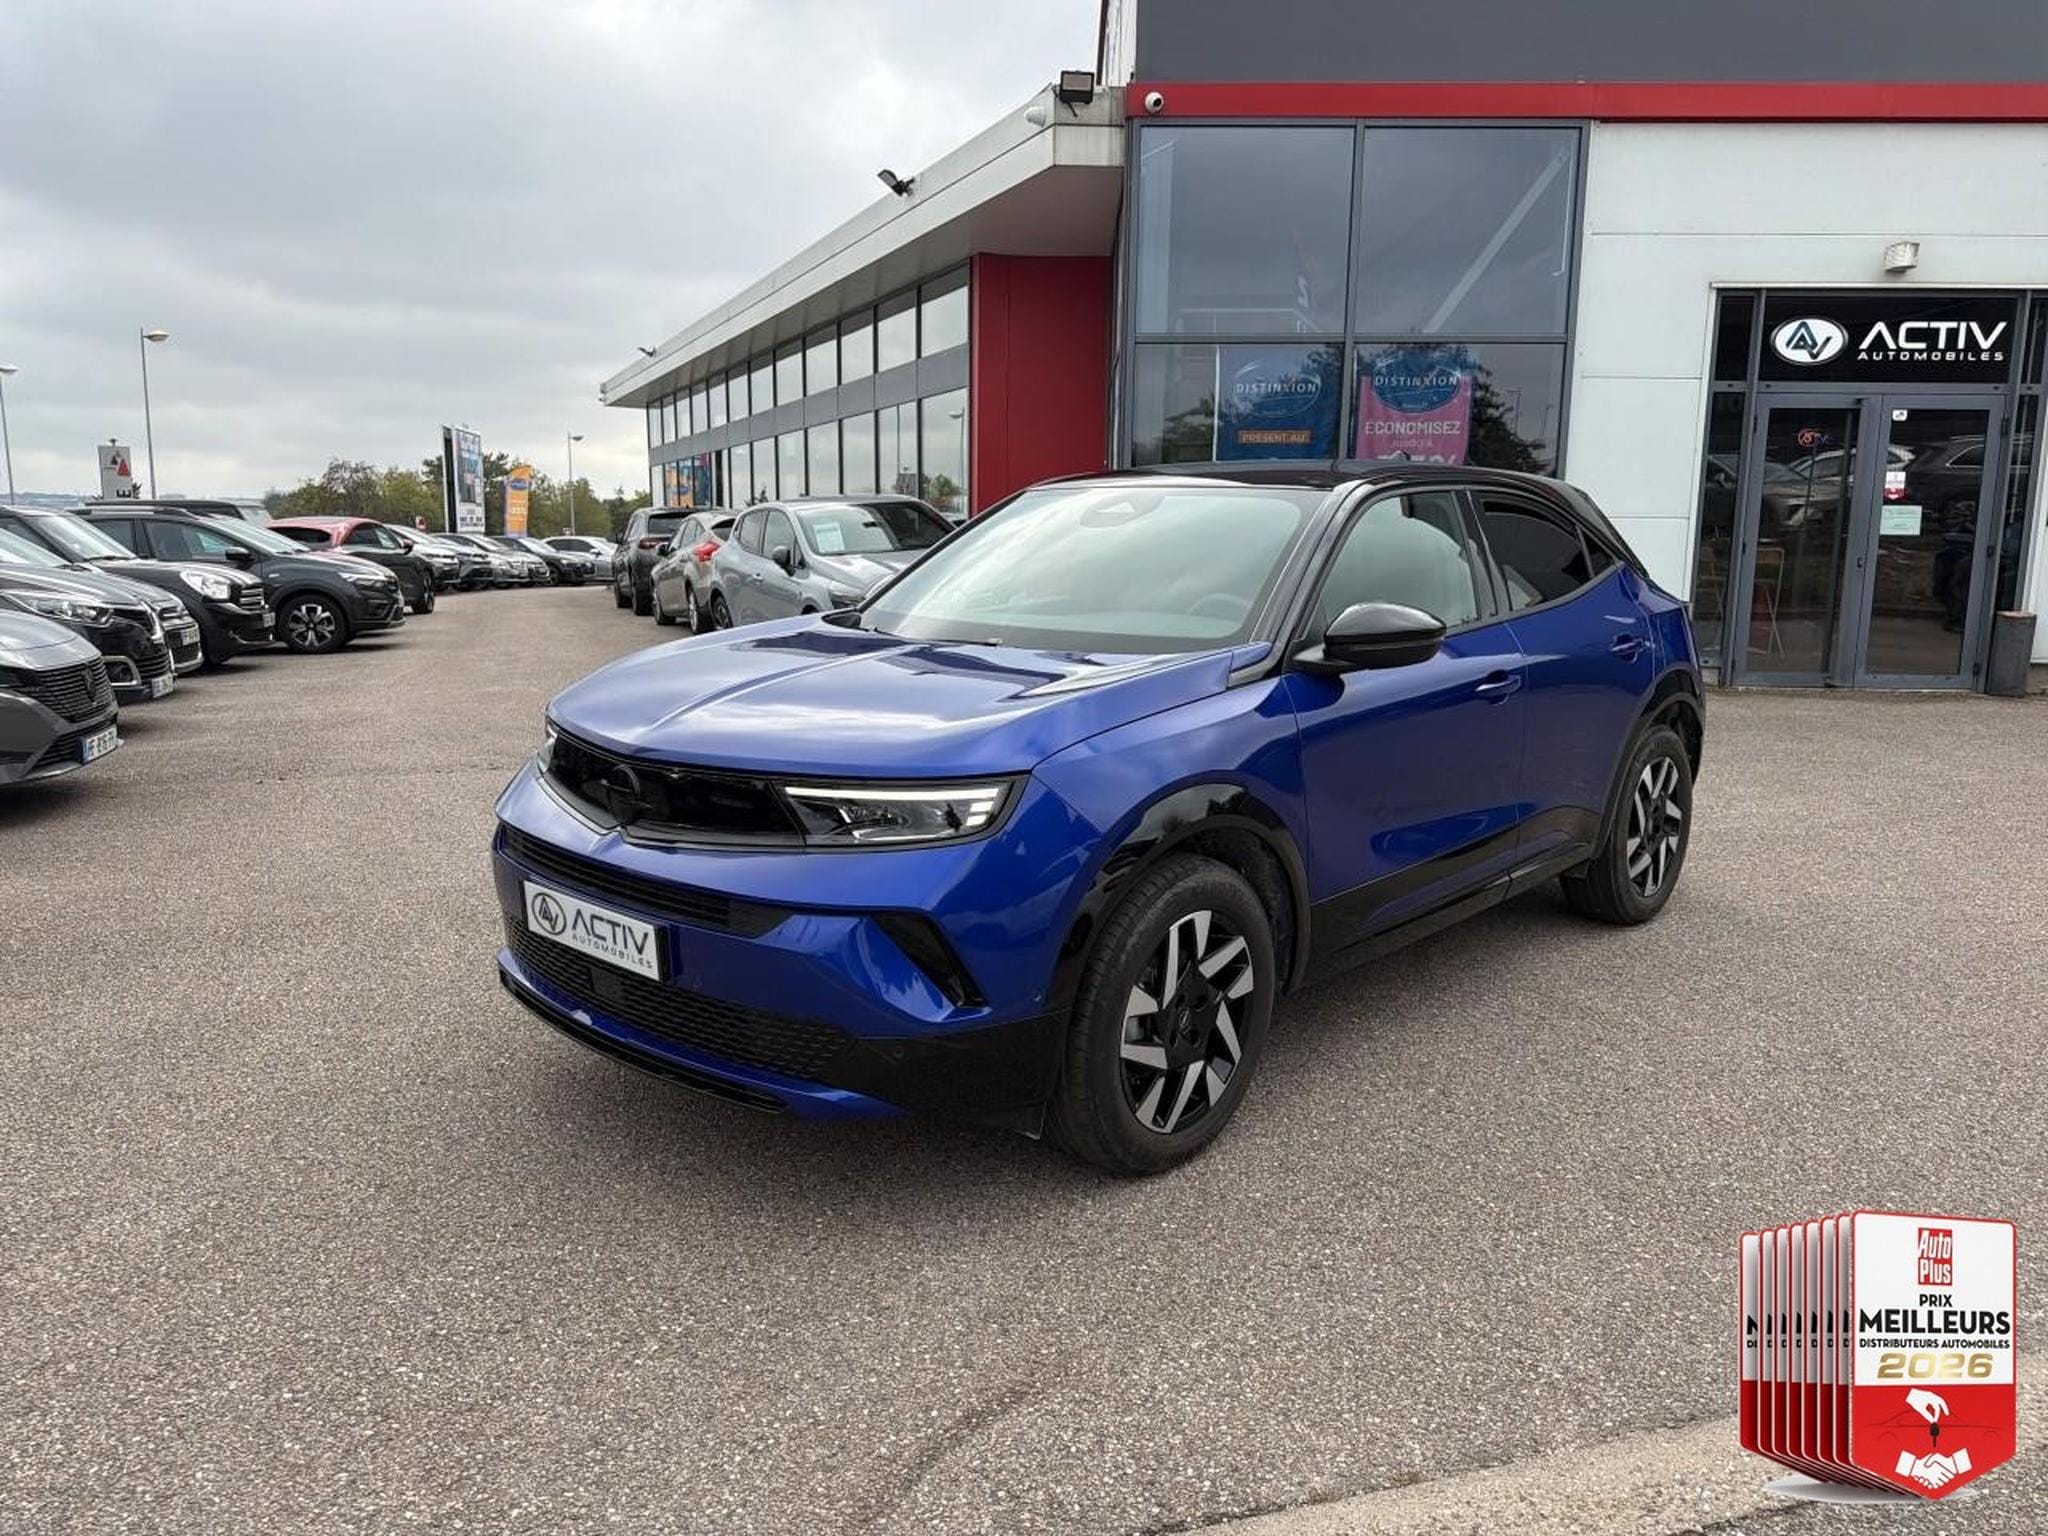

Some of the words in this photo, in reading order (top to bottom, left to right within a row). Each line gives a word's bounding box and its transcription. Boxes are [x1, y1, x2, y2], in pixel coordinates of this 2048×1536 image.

[1858, 321, 2007, 350] ACTIV
[1857, 351, 2004, 361] AUTOMOBILES
[1236, 382, 1317, 394] DISTINXION
[1375, 376, 1458, 387] DISTINXION
[572, 909, 649, 955] ACTIV
[572, 935, 653, 969] AUTOMOBILES
